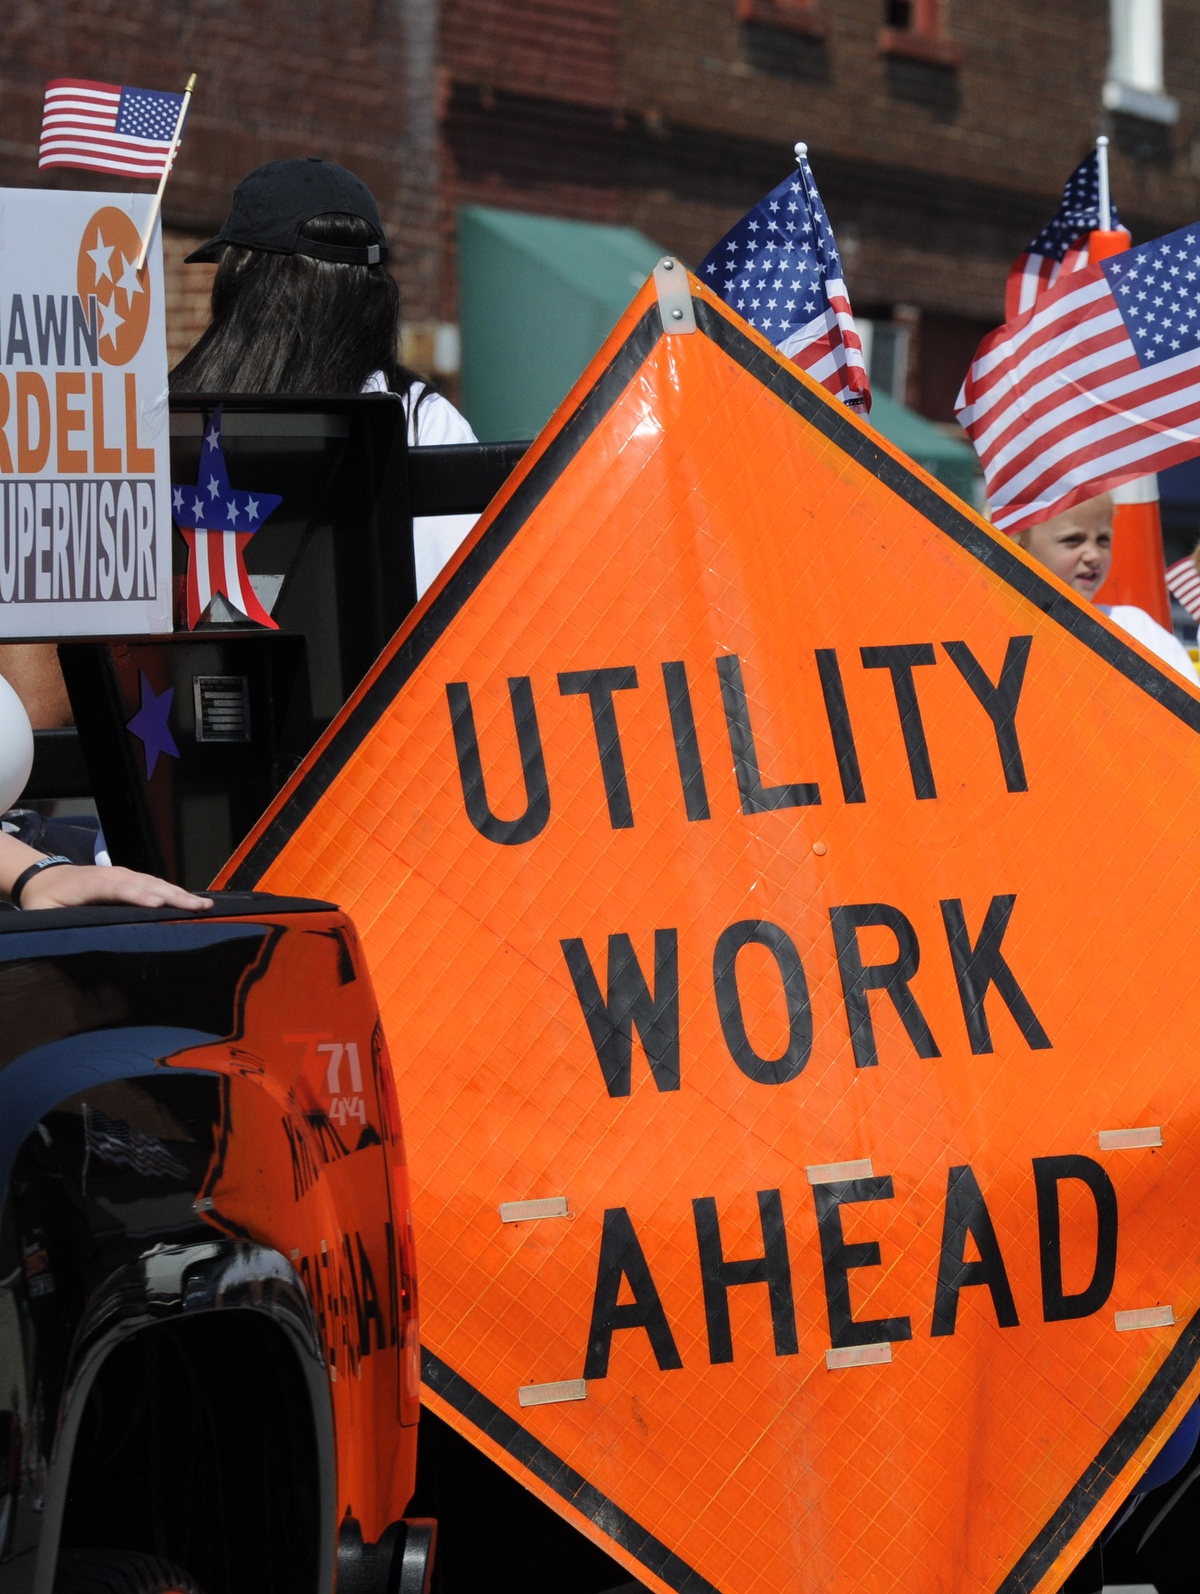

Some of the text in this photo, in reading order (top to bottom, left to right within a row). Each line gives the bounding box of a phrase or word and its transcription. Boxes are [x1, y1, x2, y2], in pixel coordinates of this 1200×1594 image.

[0, 293, 99, 367] AWN
[445, 635, 1034, 846] UTILITY
[559, 894, 1053, 1099] WORK
[583, 1154, 1119, 1380] AHEAD
